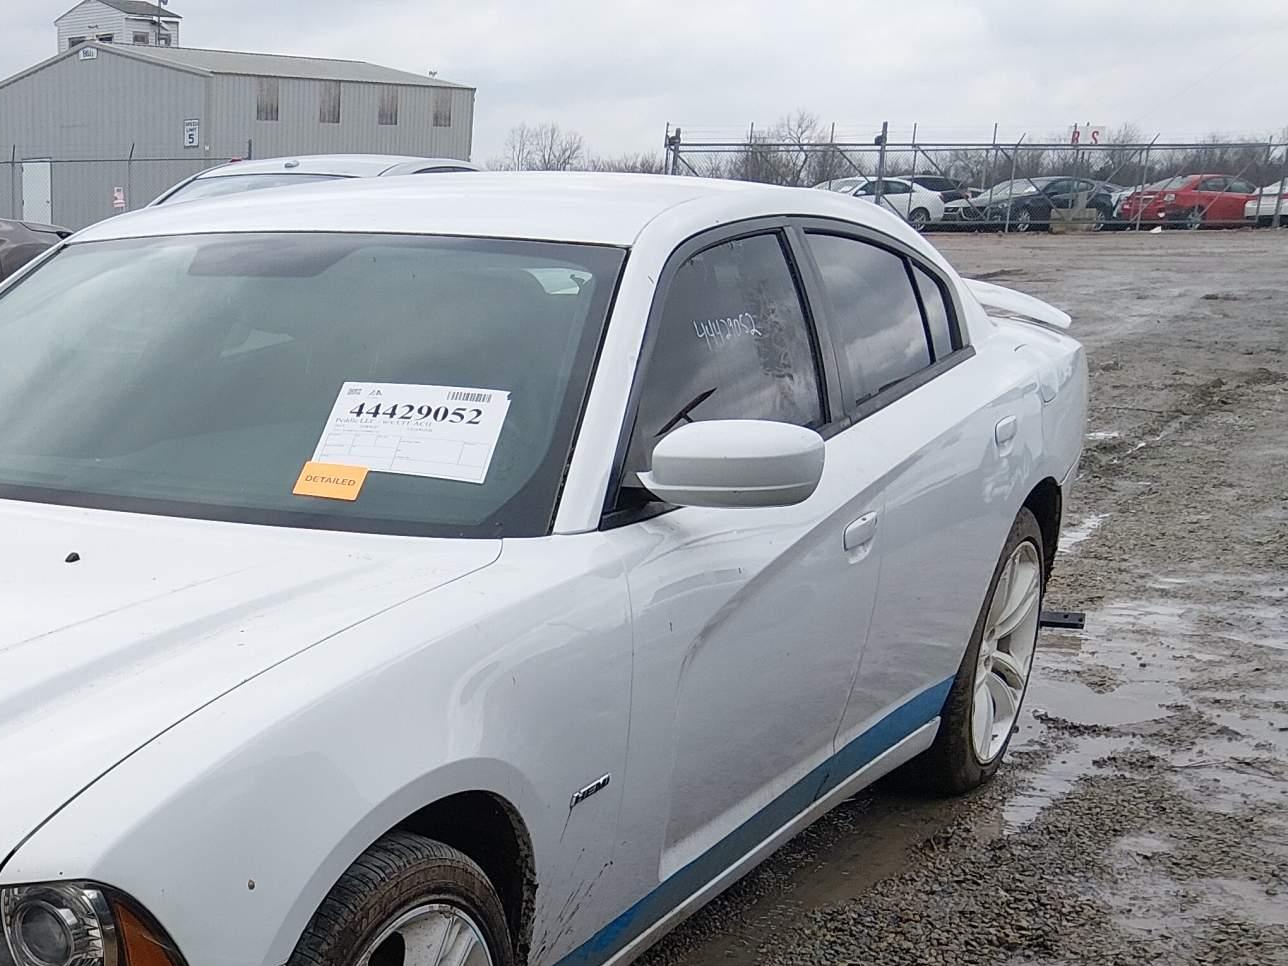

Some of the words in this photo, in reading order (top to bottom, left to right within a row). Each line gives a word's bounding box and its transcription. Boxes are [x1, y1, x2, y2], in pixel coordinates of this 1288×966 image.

[188, 133, 195, 144] 5
[693, 312, 763, 352] 44429052
[348, 402, 483, 425] 44429052
[304, 474, 357, 487] DETAILED
[571, 773, 611, 808] HEMI
